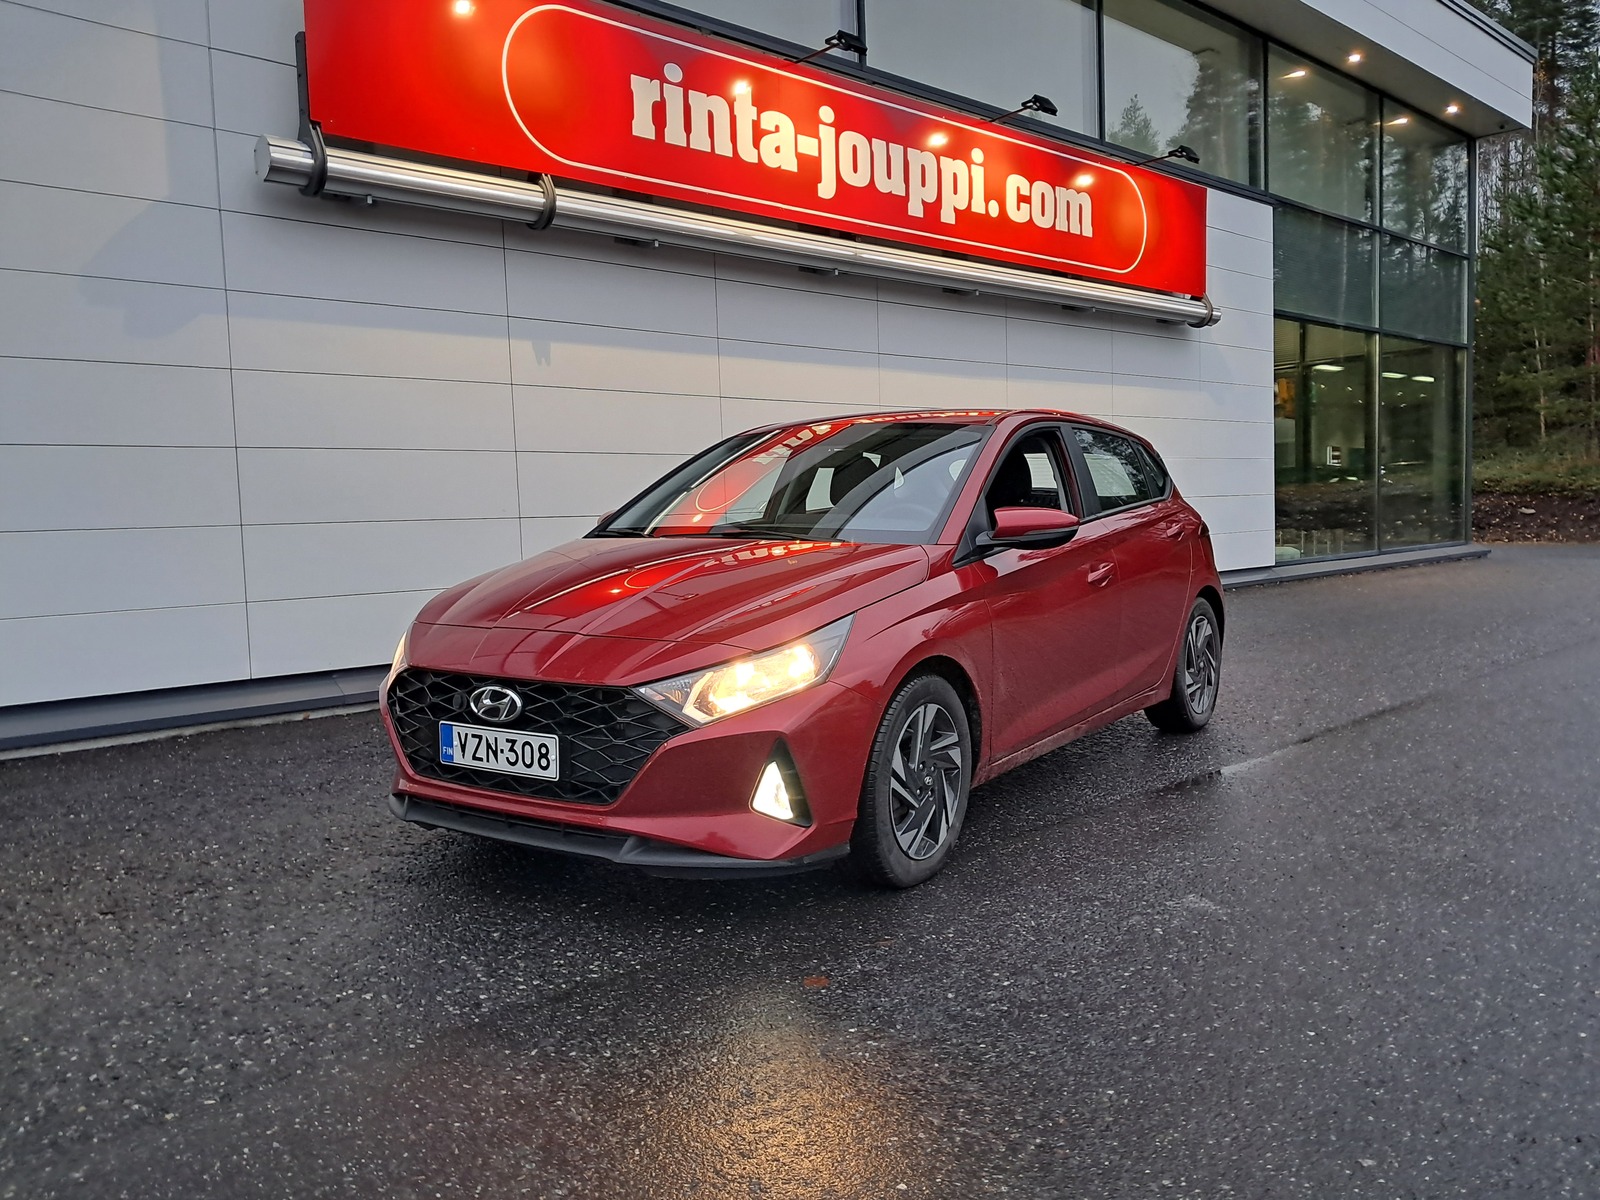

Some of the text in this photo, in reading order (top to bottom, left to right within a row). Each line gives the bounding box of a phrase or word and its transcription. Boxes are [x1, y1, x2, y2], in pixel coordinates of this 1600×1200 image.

[630, 63, 1093, 237] rinta-jouppi.com
[443, 746, 454, 755] FIN
[457, 731, 551, 770] VZN-308
